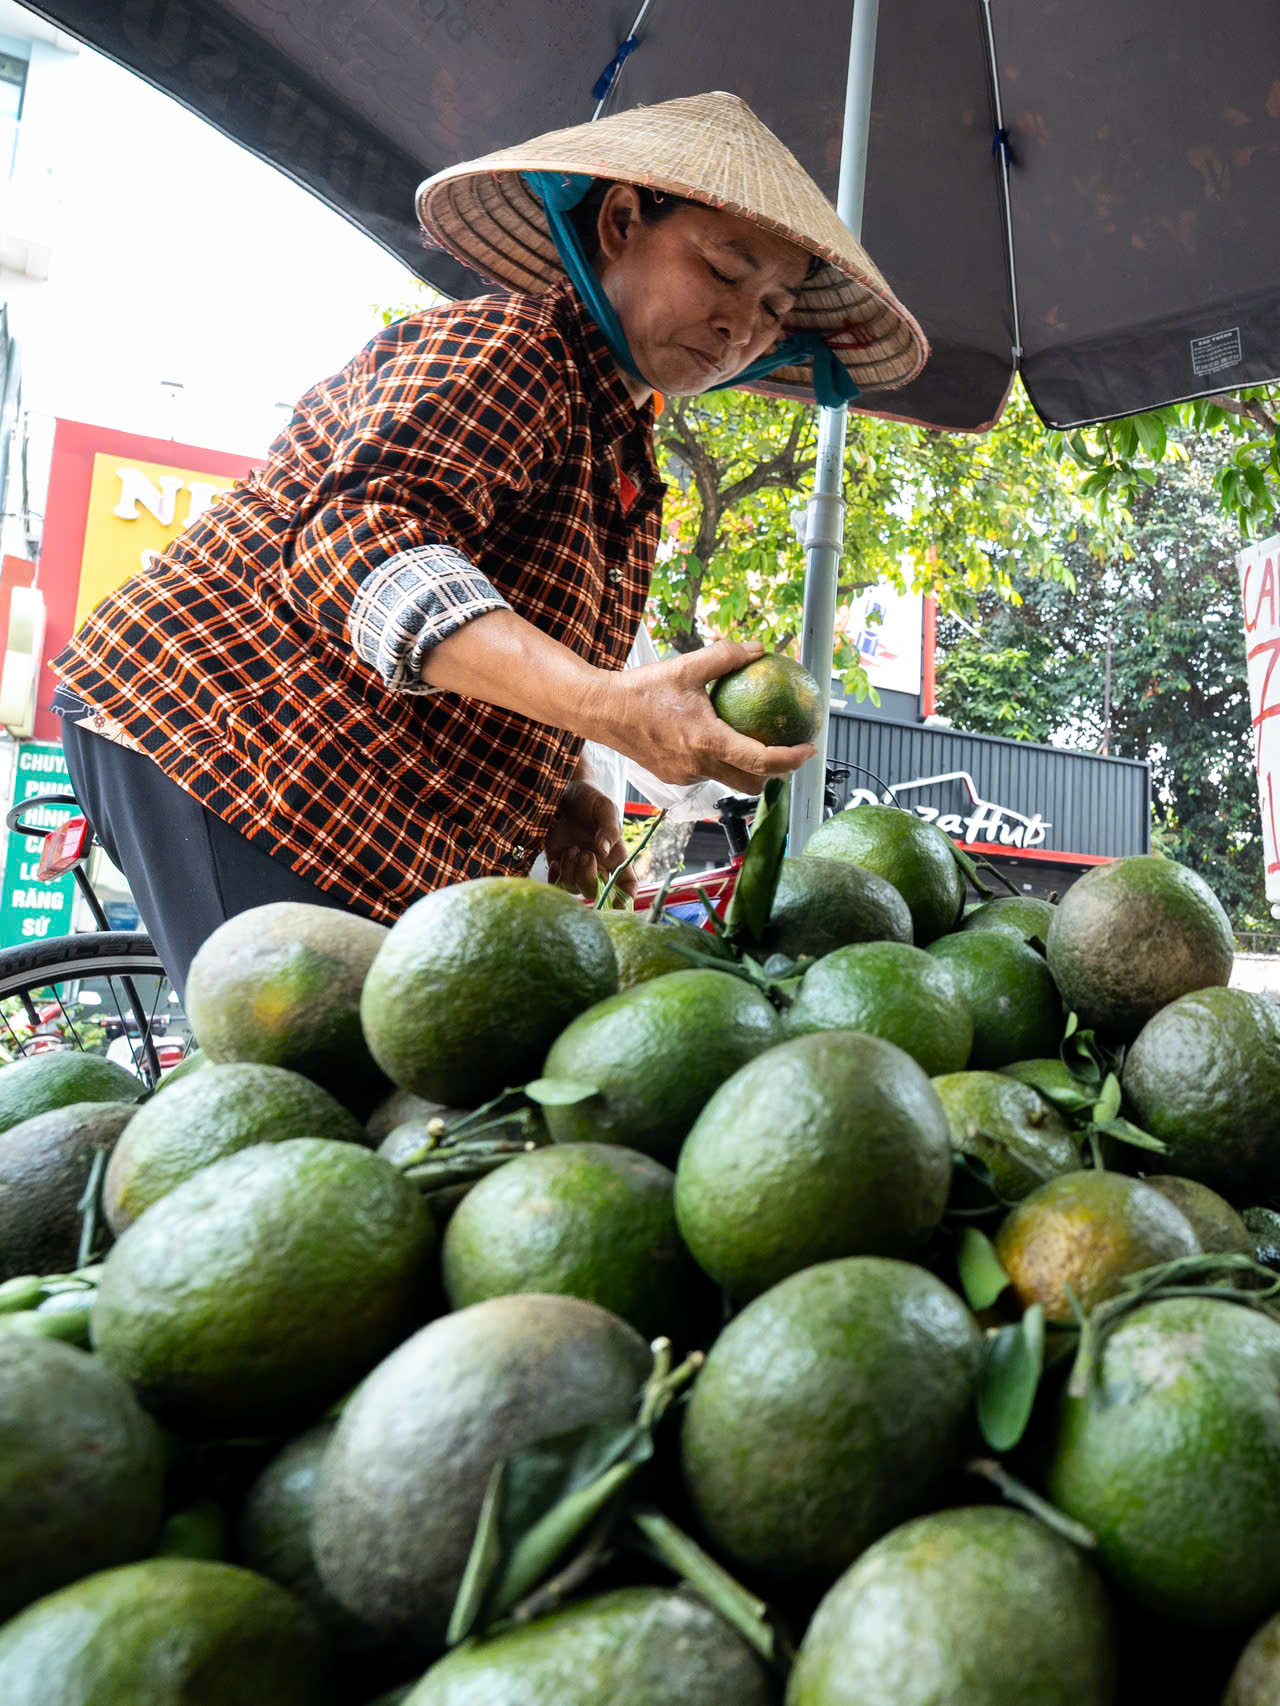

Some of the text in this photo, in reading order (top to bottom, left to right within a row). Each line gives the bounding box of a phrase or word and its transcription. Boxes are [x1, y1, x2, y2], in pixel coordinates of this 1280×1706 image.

[19, 751, 68, 774] CHUY
[12, 888, 64, 910] RĂNG
[22, 915, 51, 937] SỨ
